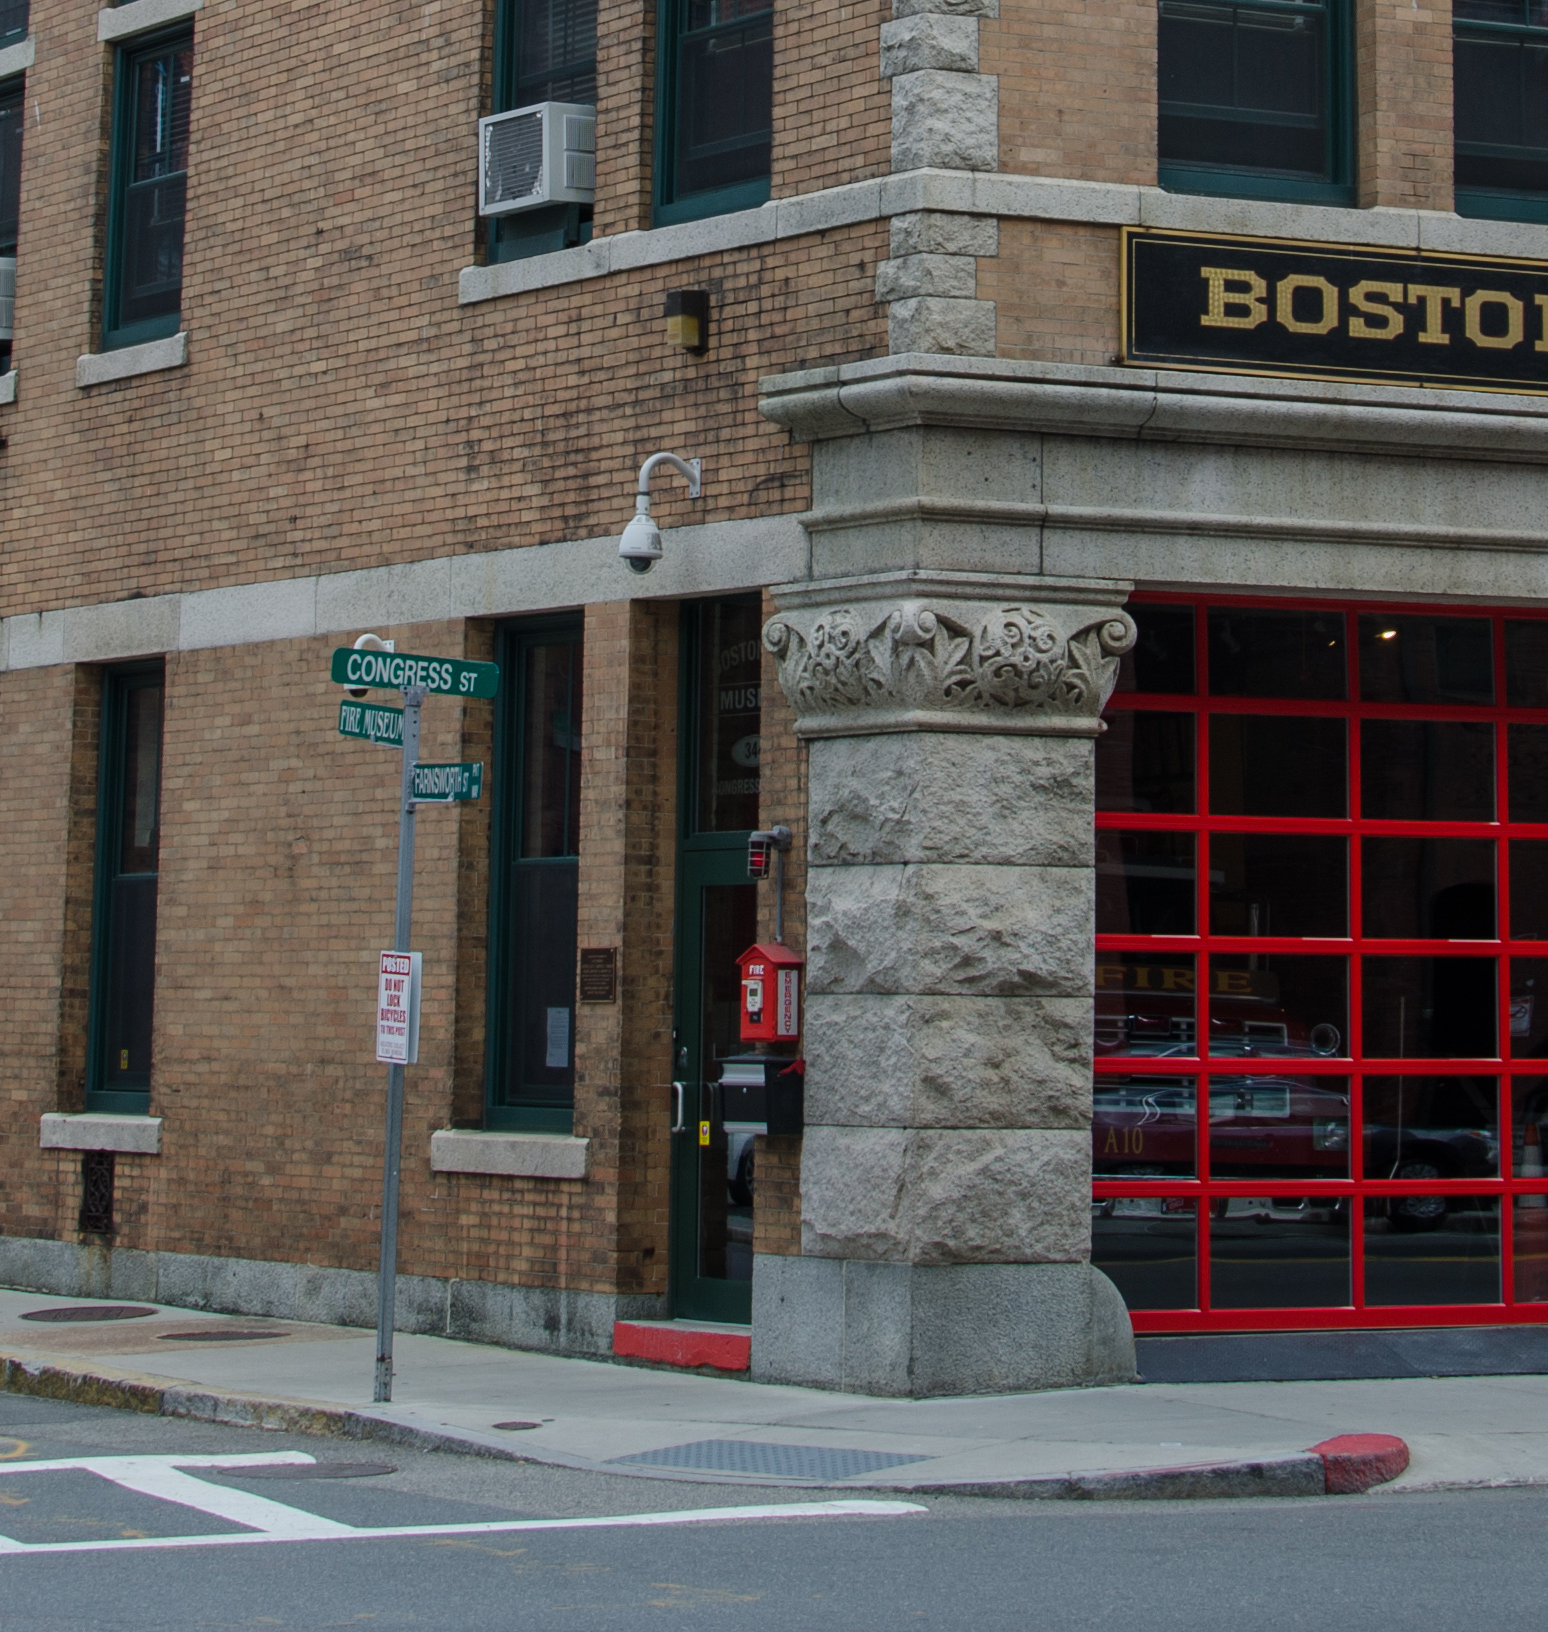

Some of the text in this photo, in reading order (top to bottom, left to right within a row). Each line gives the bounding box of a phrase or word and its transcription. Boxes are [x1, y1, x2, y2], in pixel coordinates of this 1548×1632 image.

[721, 639, 761, 671] OSTO
[347, 654, 478, 692] CONGRESS ST
[340, 705, 362, 733] FIRE
[745, 740, 761, 759] 34
[414, 767, 469, 794] FARNSWORTH ST
[382, 956, 409, 973] POSTED
[749, 964, 765, 975] FIRE
[385, 978, 404, 993] DO NOT
[1096, 965, 1253, 993] FIRE
[387, 994, 400, 1007] LOCK
[784, 971, 792, 1034] EMERGENCY
[381, 1008, 406, 1023] BICYCLES
[1104, 1126, 1144, 1155] A10
